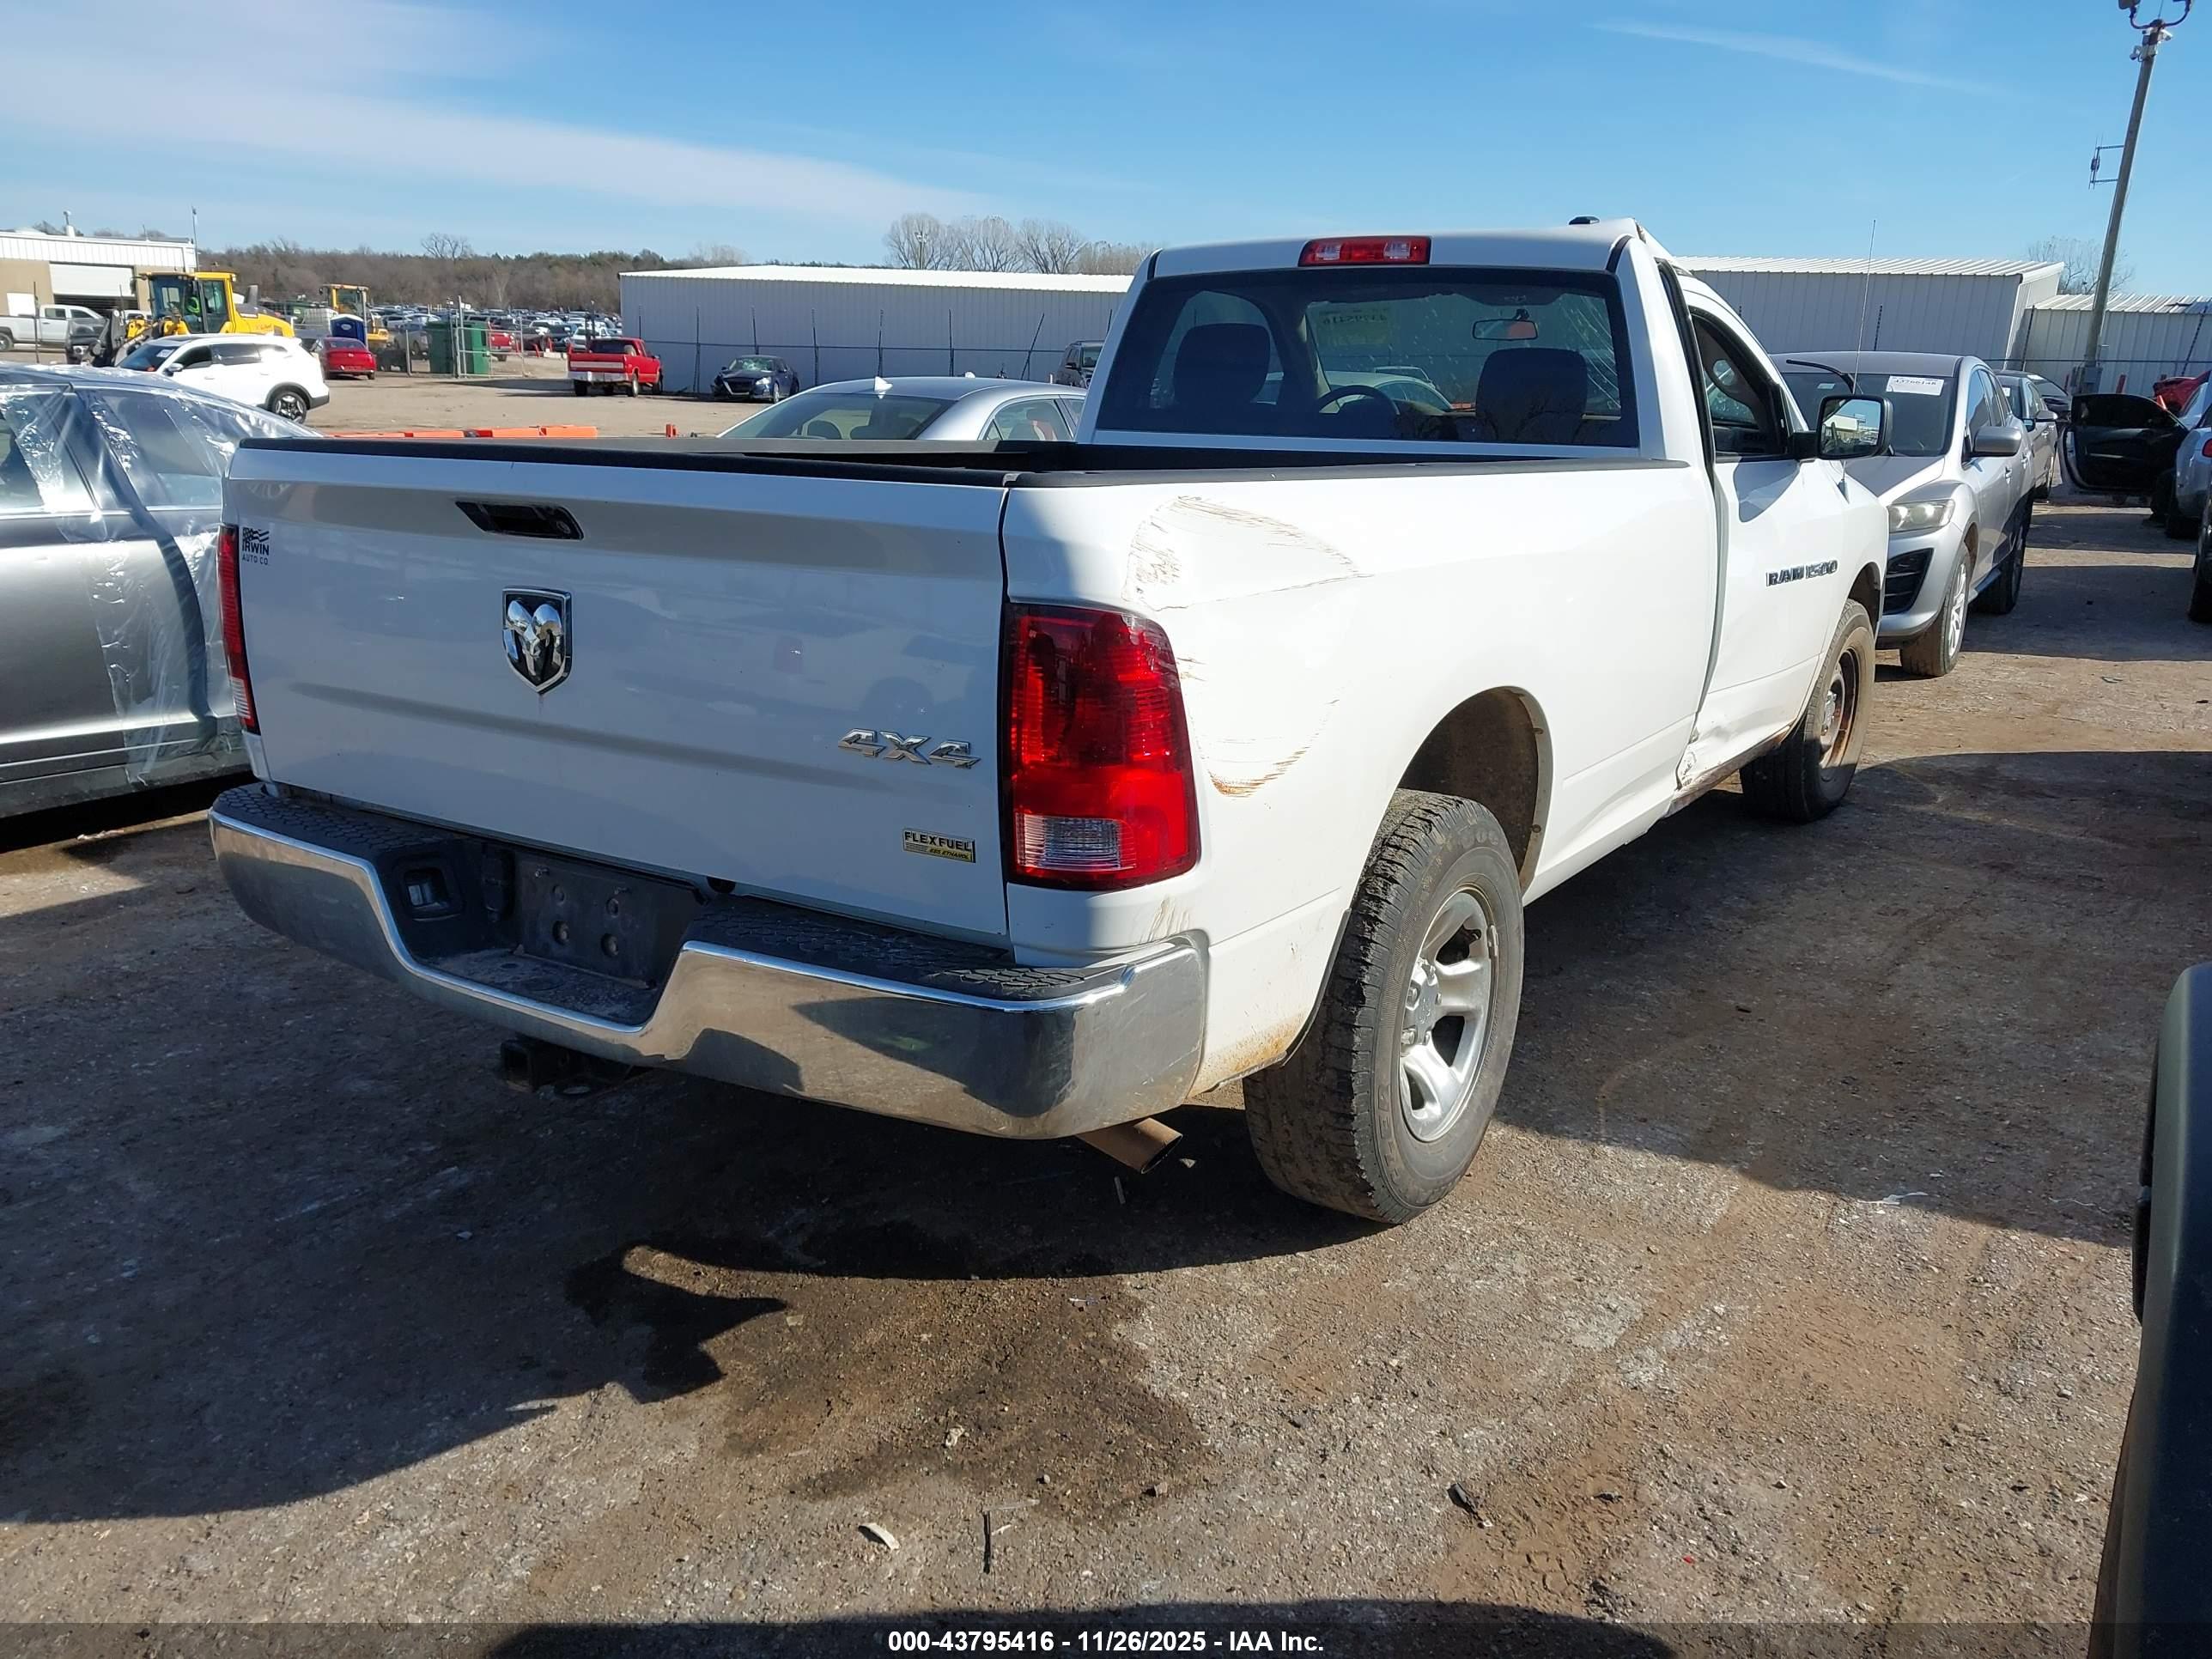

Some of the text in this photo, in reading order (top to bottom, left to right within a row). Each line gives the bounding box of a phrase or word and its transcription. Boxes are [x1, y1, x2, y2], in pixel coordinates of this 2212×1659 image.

[242, 541, 270, 556] IRWIN
[242, 554, 258, 563] AUTO
[1765, 560, 1838, 586] RAM 1500
[838, 728, 981, 769] 4X4
[904, 830, 972, 852] FLEXFUEL
